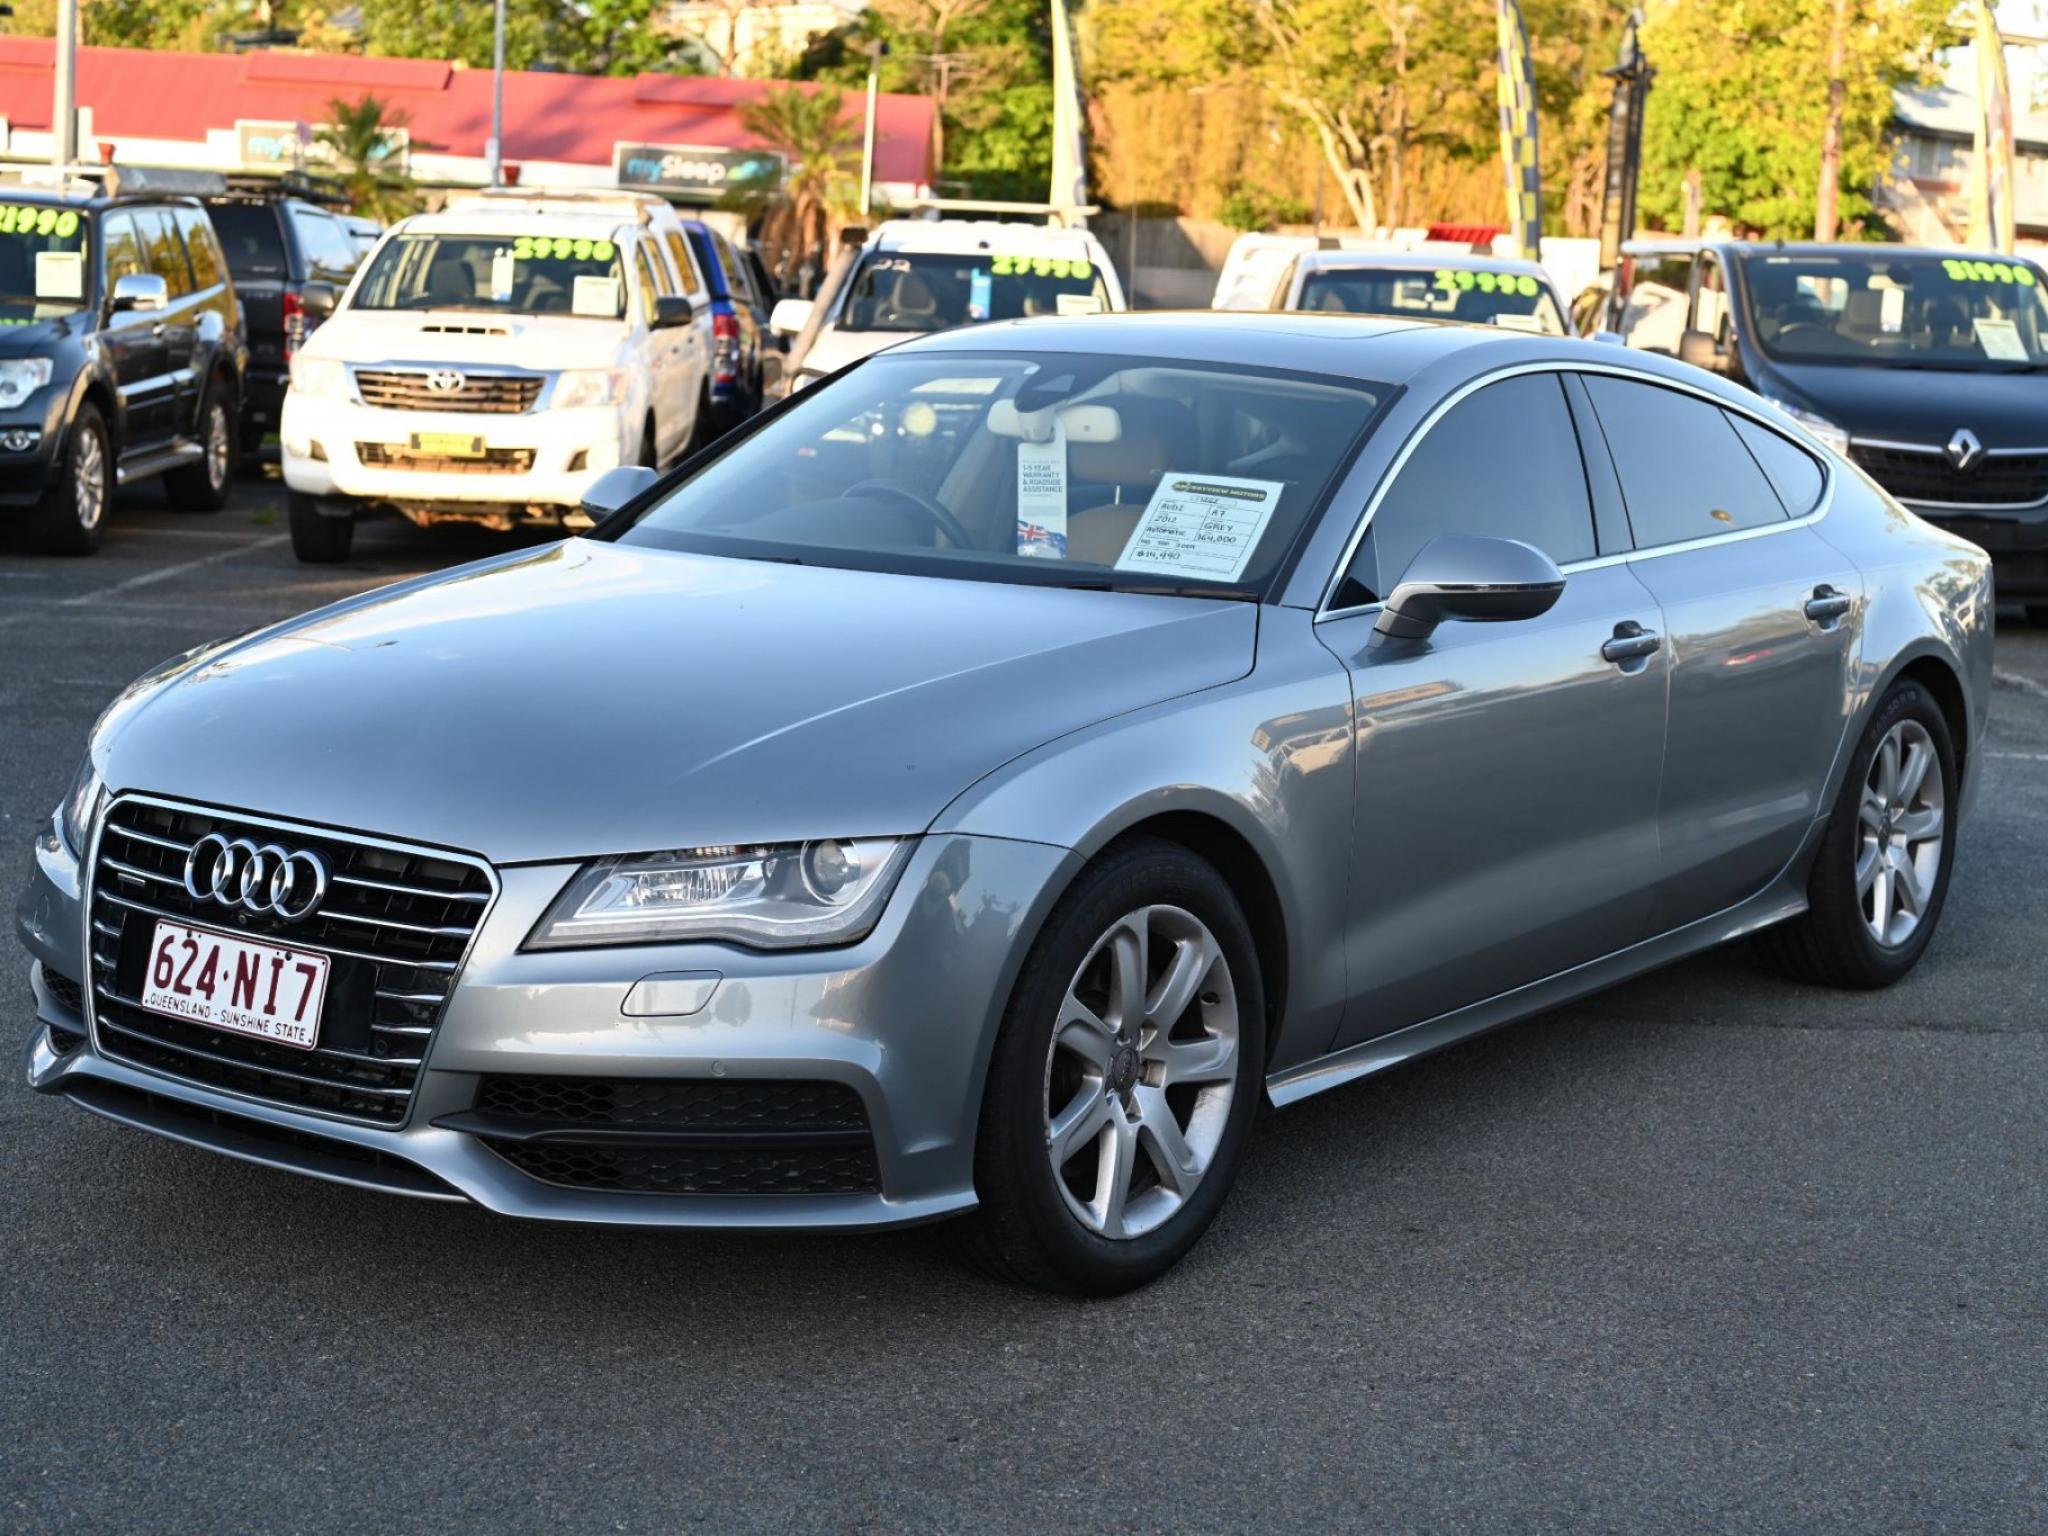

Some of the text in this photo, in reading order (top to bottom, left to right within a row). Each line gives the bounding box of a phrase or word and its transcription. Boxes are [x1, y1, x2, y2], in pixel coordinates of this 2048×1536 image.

[626, 154, 726, 185] mySleep
[1154, 515, 1177, 523] 2012
[1204, 522, 1234, 532] GREY
[150, 992, 211, 1018] QUEENSLAND
[220, 1009, 270, 1033] SUNSHINE
[275, 1022, 307, 1042] STATE
